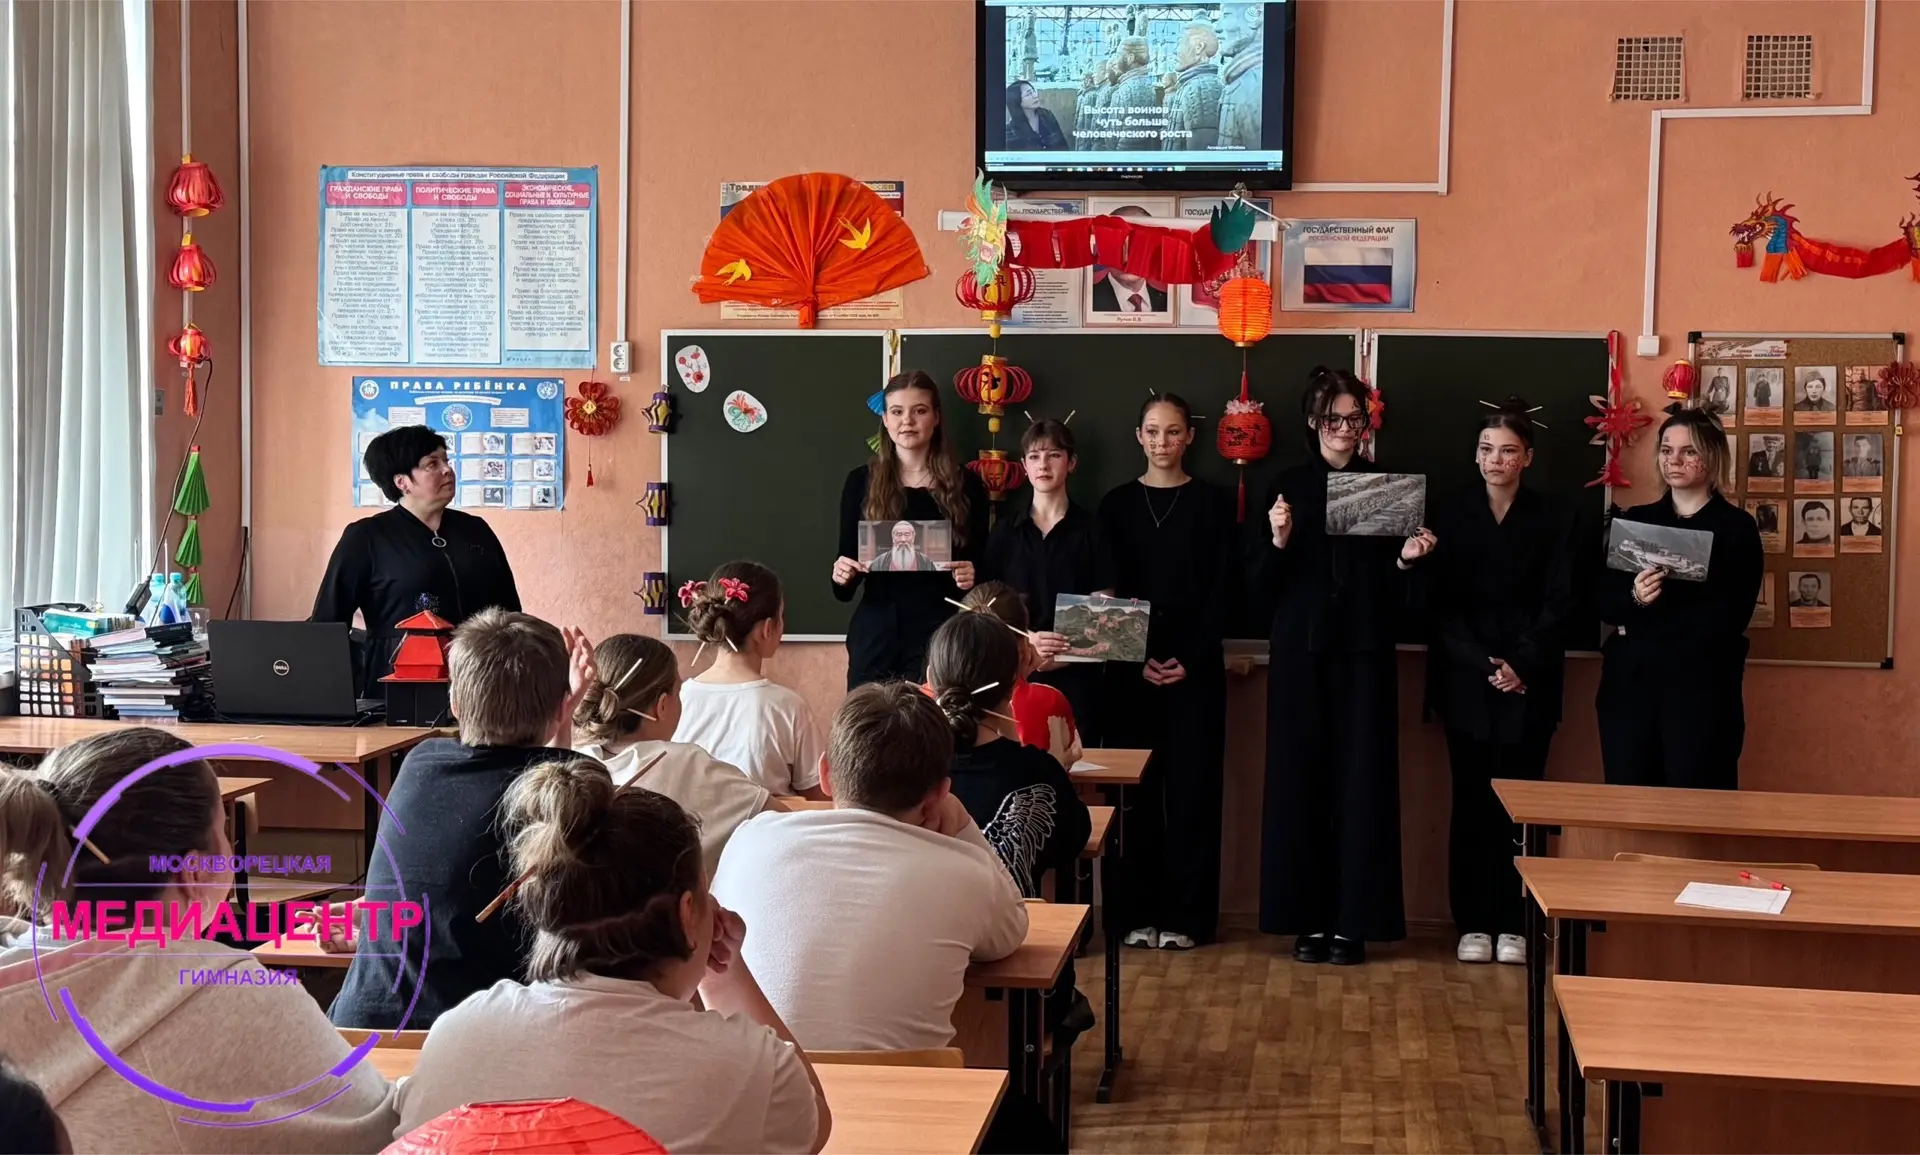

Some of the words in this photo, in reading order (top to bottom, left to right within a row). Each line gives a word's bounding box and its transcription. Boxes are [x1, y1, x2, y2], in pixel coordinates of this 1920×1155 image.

[1084, 106, 1125, 114] Высота
[1097, 119, 1122, 128] чуть
[1125, 116, 1169, 126] больше
[1072, 130, 1158, 138] человеческого
[1160, 130, 1193, 141] роста
[442, 194, 477, 202] СВОБОДЫ
[390, 381, 444, 390] ПРАВА
[453, 381, 527, 391] РЕБЁНКА
